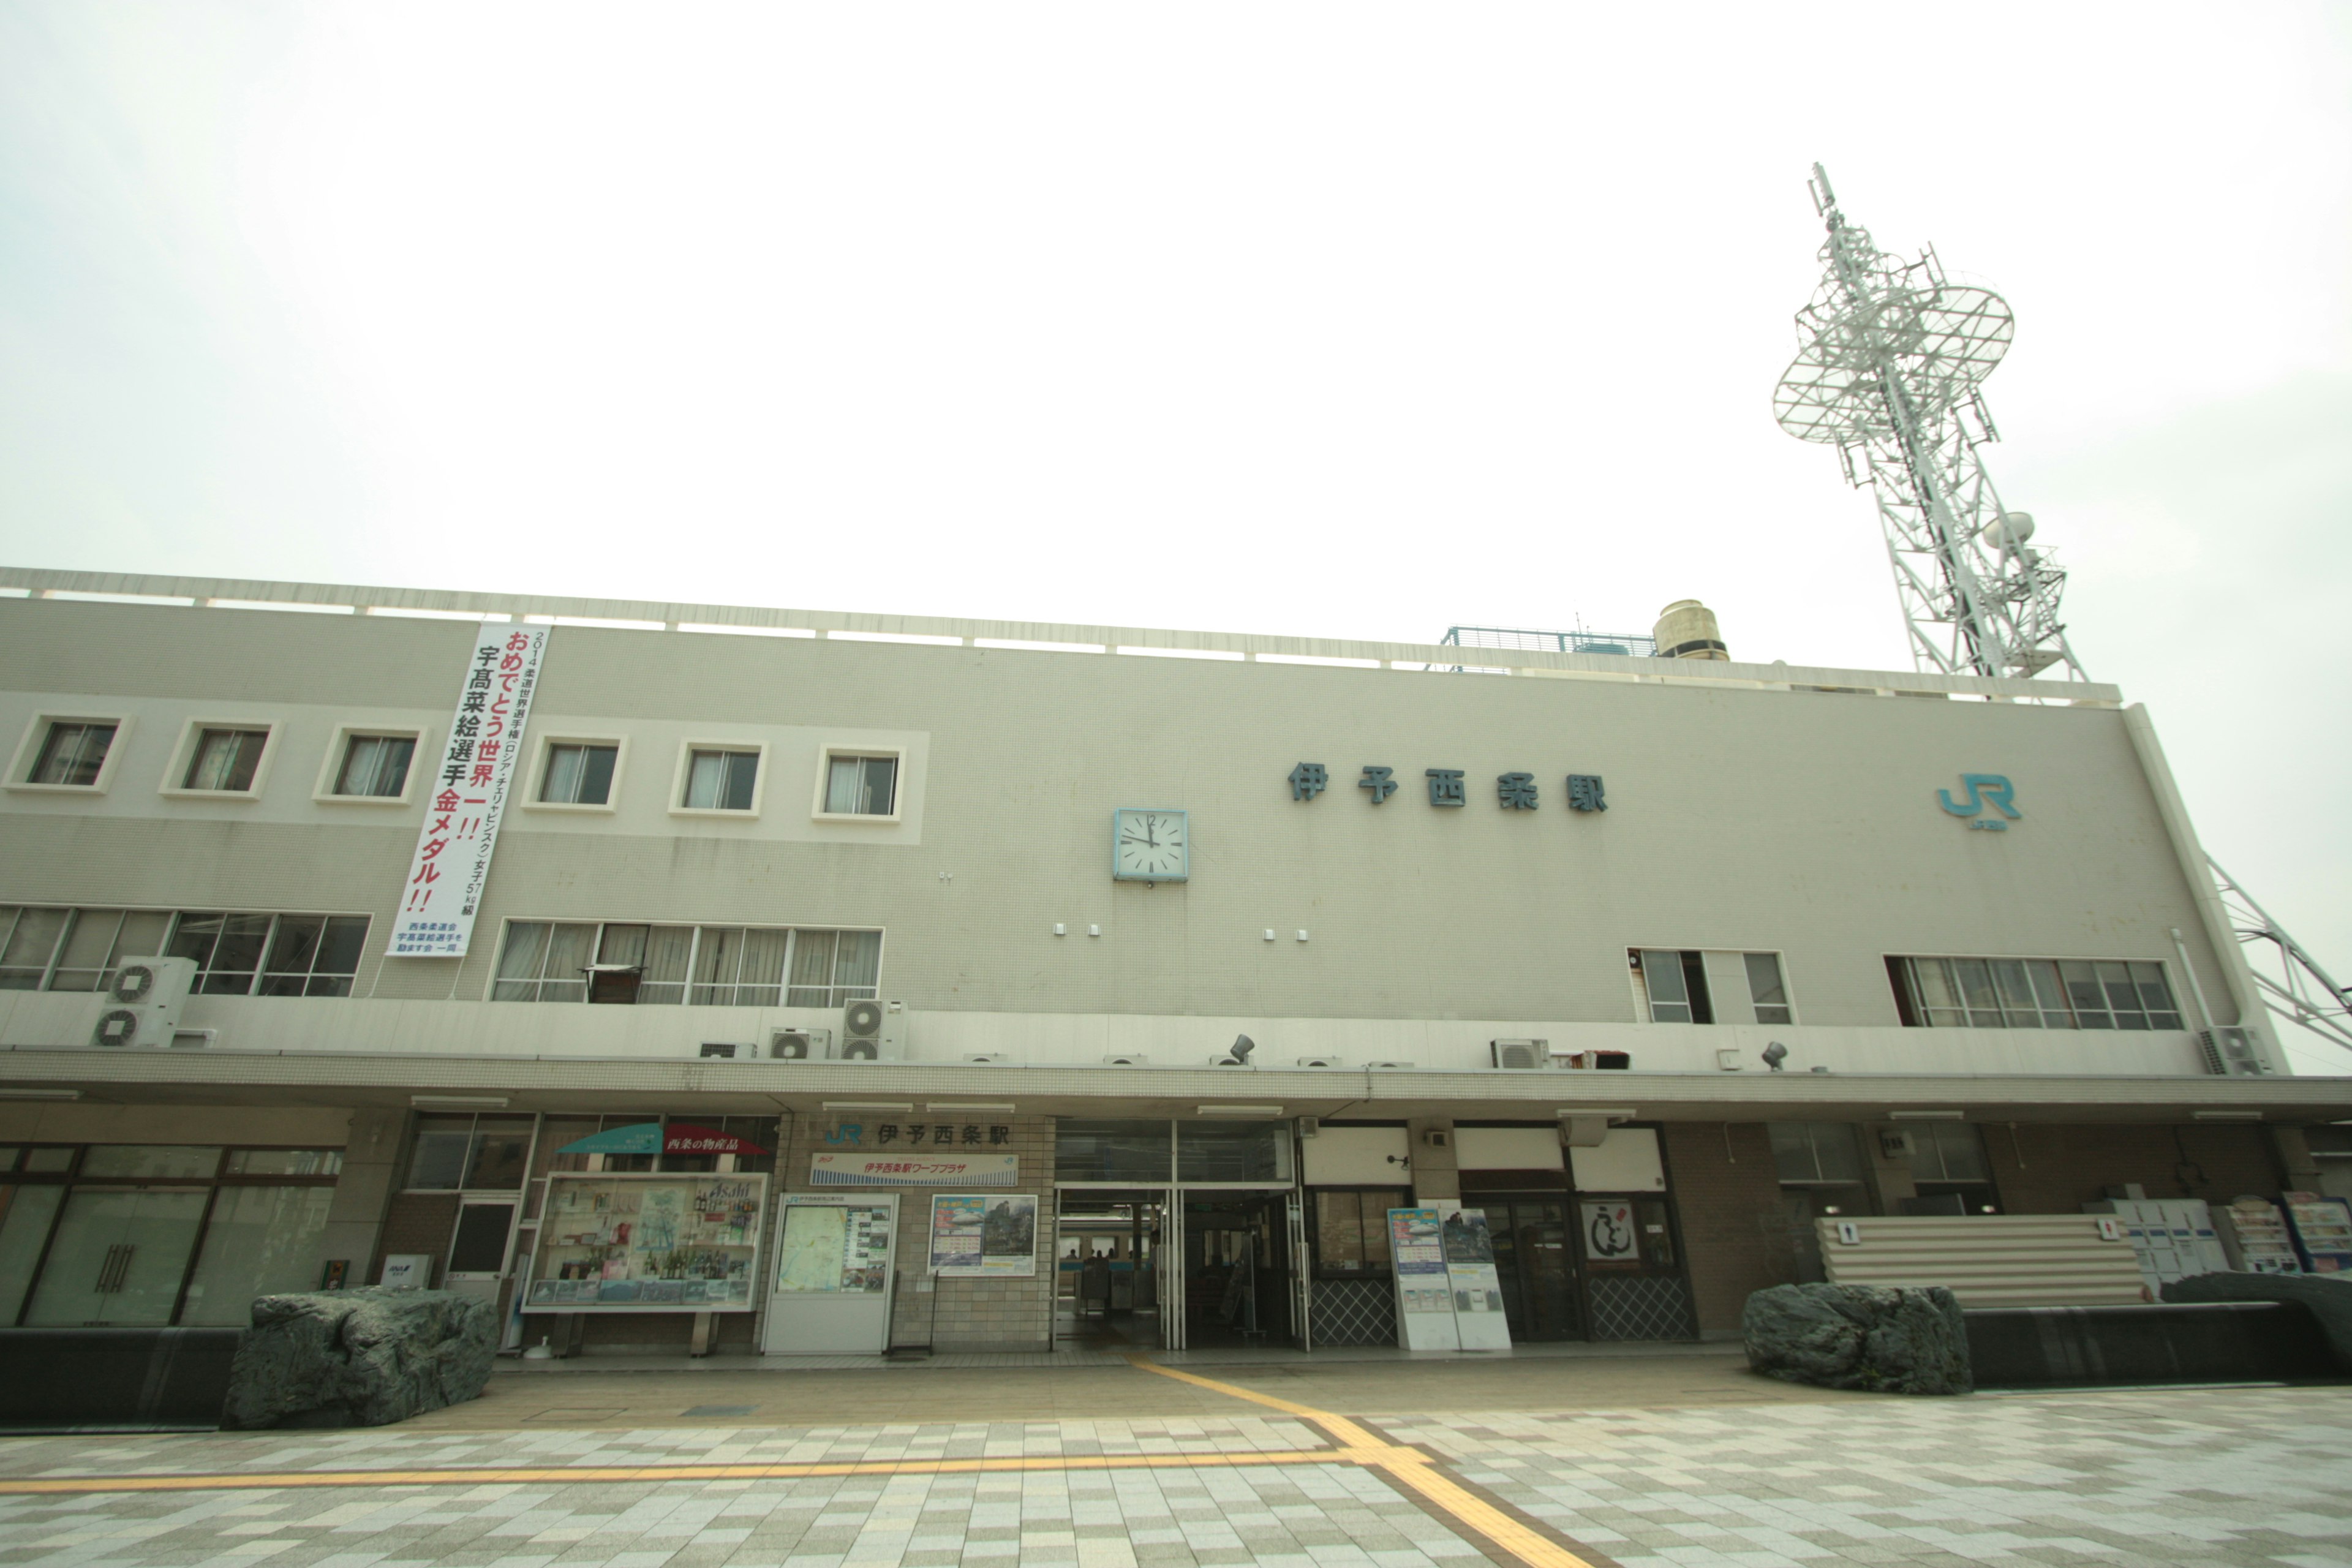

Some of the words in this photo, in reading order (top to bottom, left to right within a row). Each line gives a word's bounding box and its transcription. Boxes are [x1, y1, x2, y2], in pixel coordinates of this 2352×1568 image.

[1287, 761, 1608, 812] 伊予西条駅
[1937, 774, 2022, 819] JR
[666, 1137, 739, 1150] 西条の物産品
[825, 1124, 862, 1145] JR
[878, 1124, 1009, 1145] 伊予西条駅
[864, 1163, 967, 1174] 伊予西条駅ワーププラザ
[709, 1182, 750, 1198] Asahi
